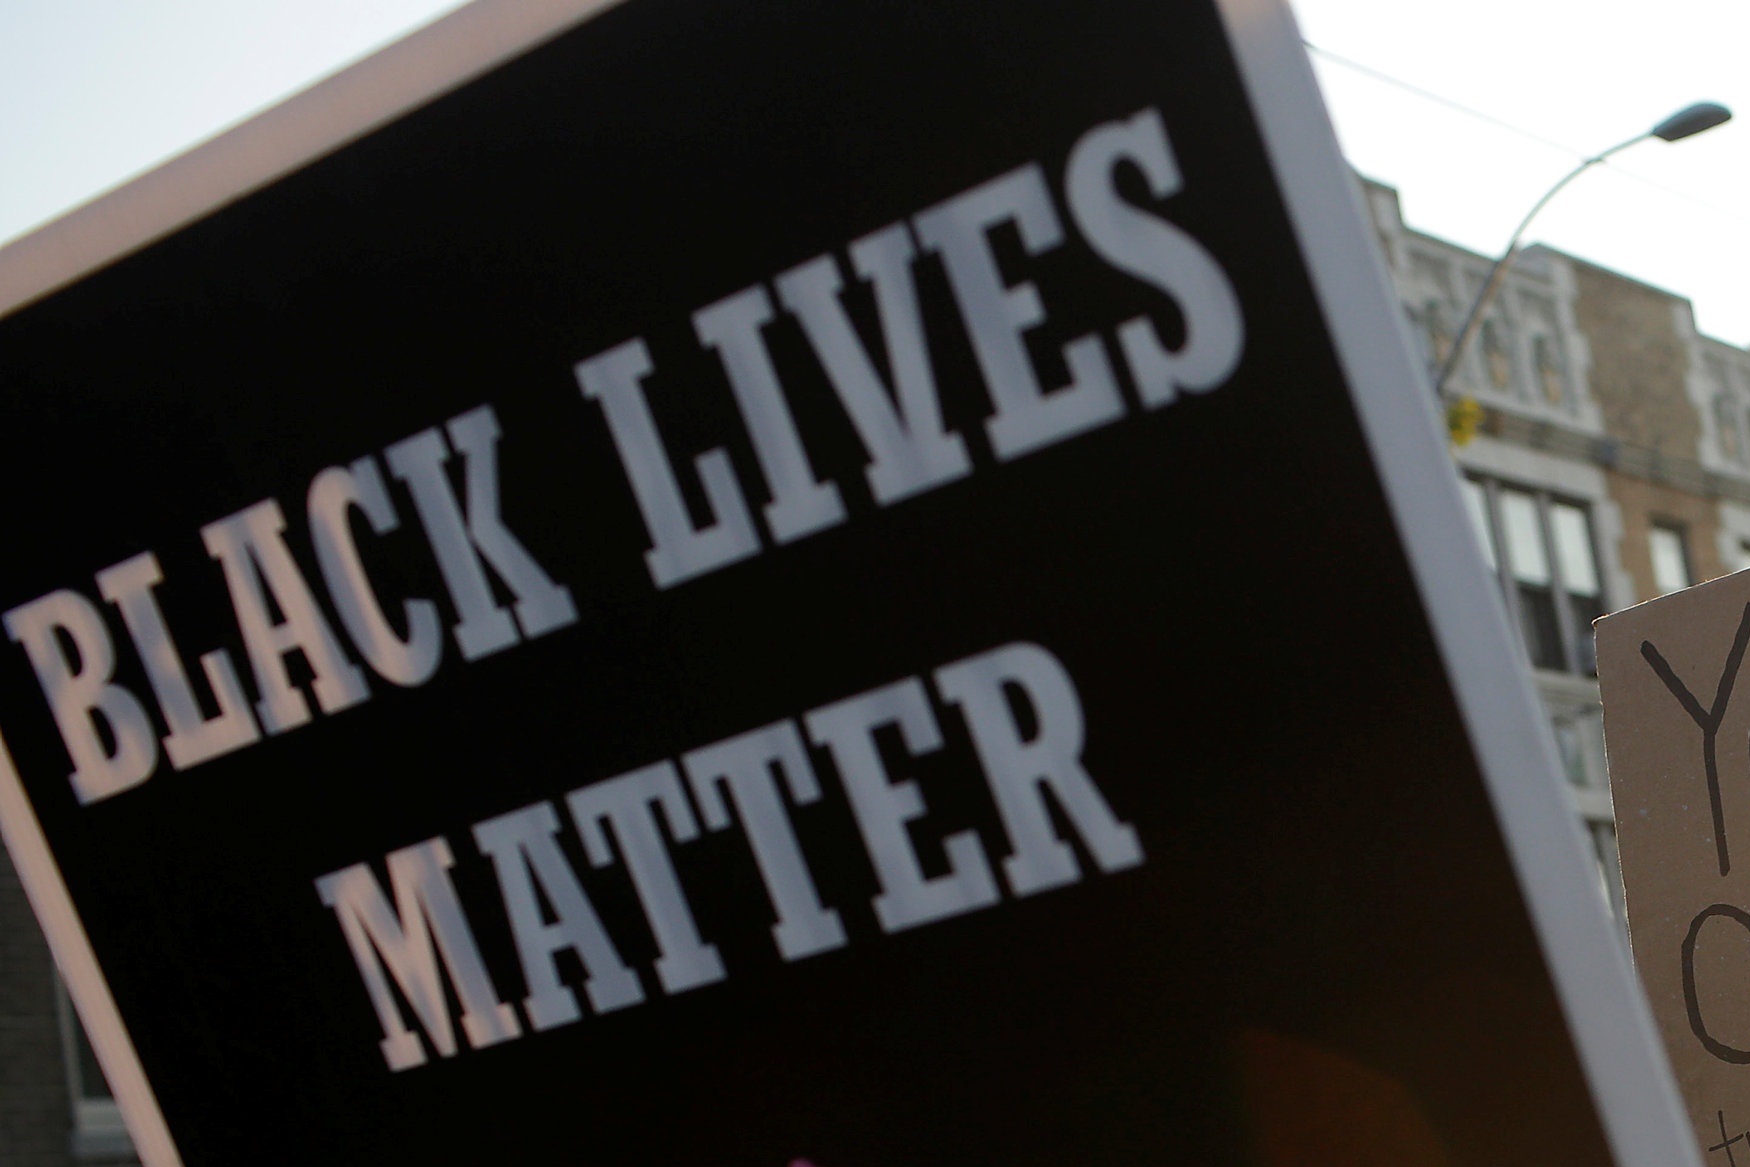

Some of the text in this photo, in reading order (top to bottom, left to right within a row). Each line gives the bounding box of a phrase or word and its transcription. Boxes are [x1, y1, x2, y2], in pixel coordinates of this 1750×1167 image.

[4, 106, 1245, 806] BLACK LIVES
[314, 641, 1146, 1072] MATTER
